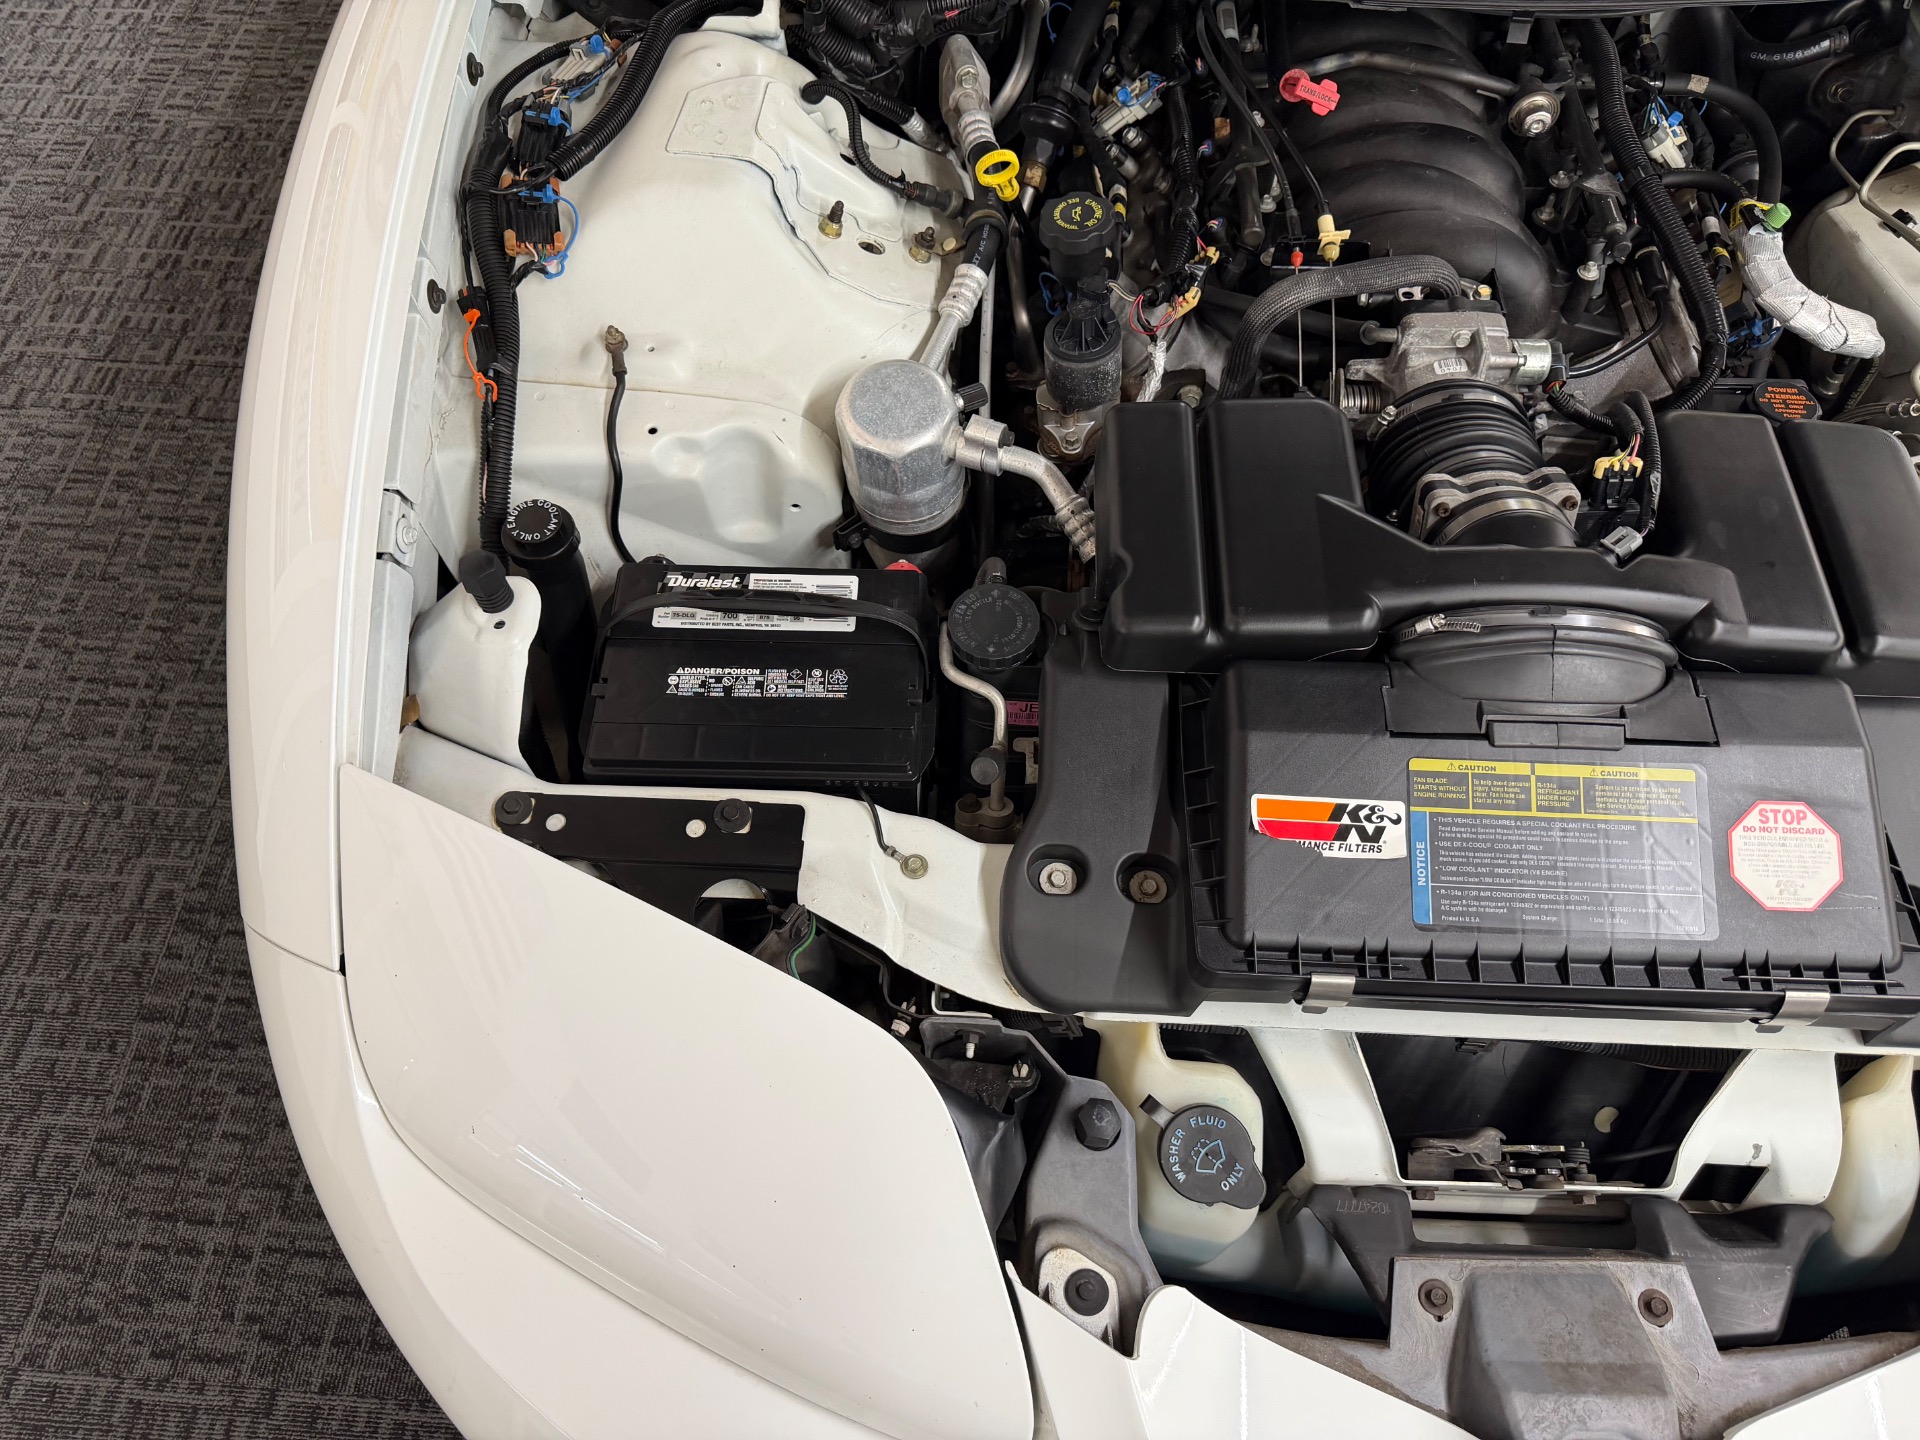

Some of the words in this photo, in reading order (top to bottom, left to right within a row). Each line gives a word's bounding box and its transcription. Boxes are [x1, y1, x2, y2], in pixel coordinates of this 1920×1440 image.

[1750, 52, 1766, 60] GM
[1300, 84, 1331, 102] TRANS/LOCK
[1084, 199, 1103, 219] ENGINE
[1056, 219, 1079, 230] MANUAL
[1084, 218, 1098, 227] OIL
[506, 500, 534, 529] ENGINE
[537, 500, 559, 536] COOLANT
[511, 529, 541, 540] ONLY
[666, 575, 741, 588] Duralast
[684, 667, 760, 675] DANGER/POISON
[1458, 764, 1497, 772] CAUTION
[1600, 770, 1638, 778] CAUTION
[1537, 800, 1570, 808] PRESSURE
[1758, 807, 1807, 825] STOP
[1327, 802, 1402, 844] K&N
[1522, 820, 1550, 828] SPECIAL
[1597, 823, 1637, 831] PROCEDURE
[1742, 825, 1756, 833] DO
[1758, 826, 1779, 834] NOT
[1781, 826, 1825, 835] DISCARD
[1338, 842, 1383, 854] FILTERS
[1416, 841, 1427, 886] NOTICE
[1494, 867, 1529, 875] INDICATOR
[1491, 891, 1537, 899] CONDITIONED
[1537, 893, 1569, 901] VEHICLES
[1569, 894, 1590, 902] ONLY)
[1169, 1128, 1187, 1183] WASHER
[1189, 1114, 1227, 1129] FLUID
[1220, 1162, 1245, 1191] ONLY
